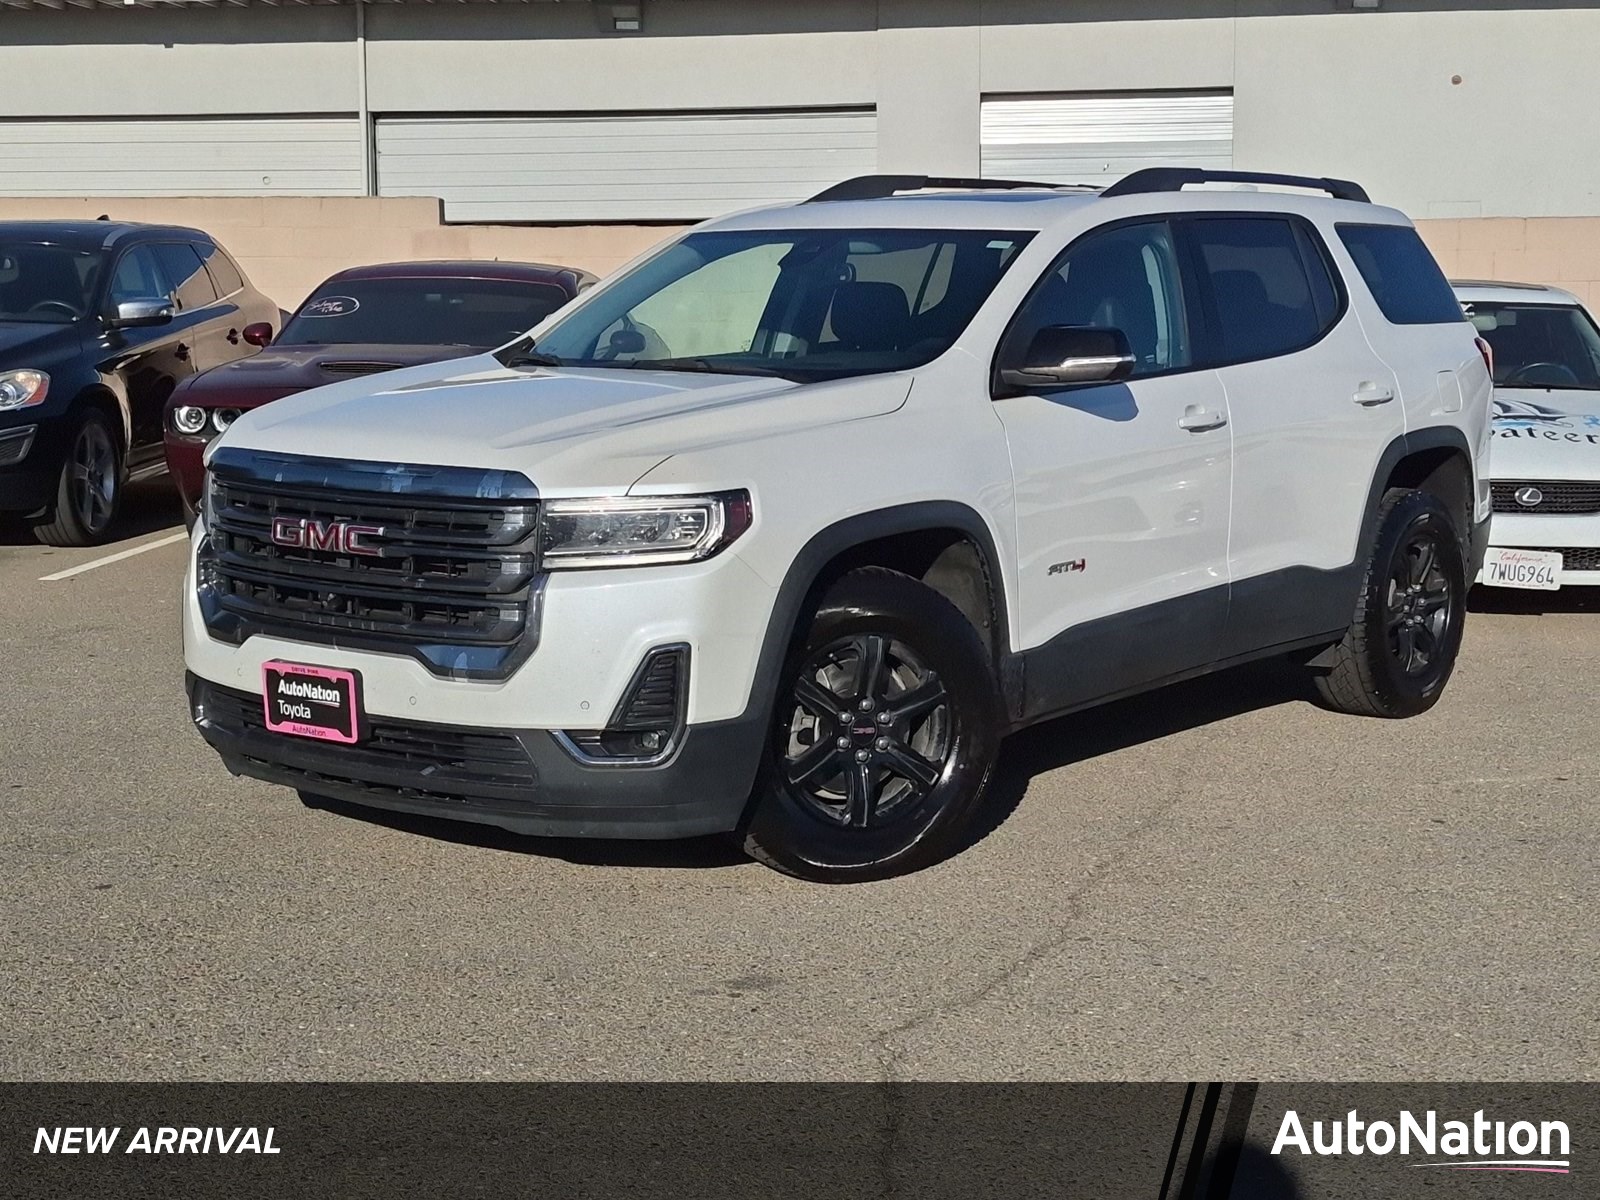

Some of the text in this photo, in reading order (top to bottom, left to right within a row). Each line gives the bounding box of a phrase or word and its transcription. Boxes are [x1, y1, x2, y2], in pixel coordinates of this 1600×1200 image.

[1492, 427, 1599, 444] ateer
[272, 516, 385, 557] GMC
[1489, 562, 1554, 584] 7WUG964
[277, 679, 341, 702] AutoNation
[277, 699, 312, 719] Toyota
[292, 724, 327, 737] AutoNation
